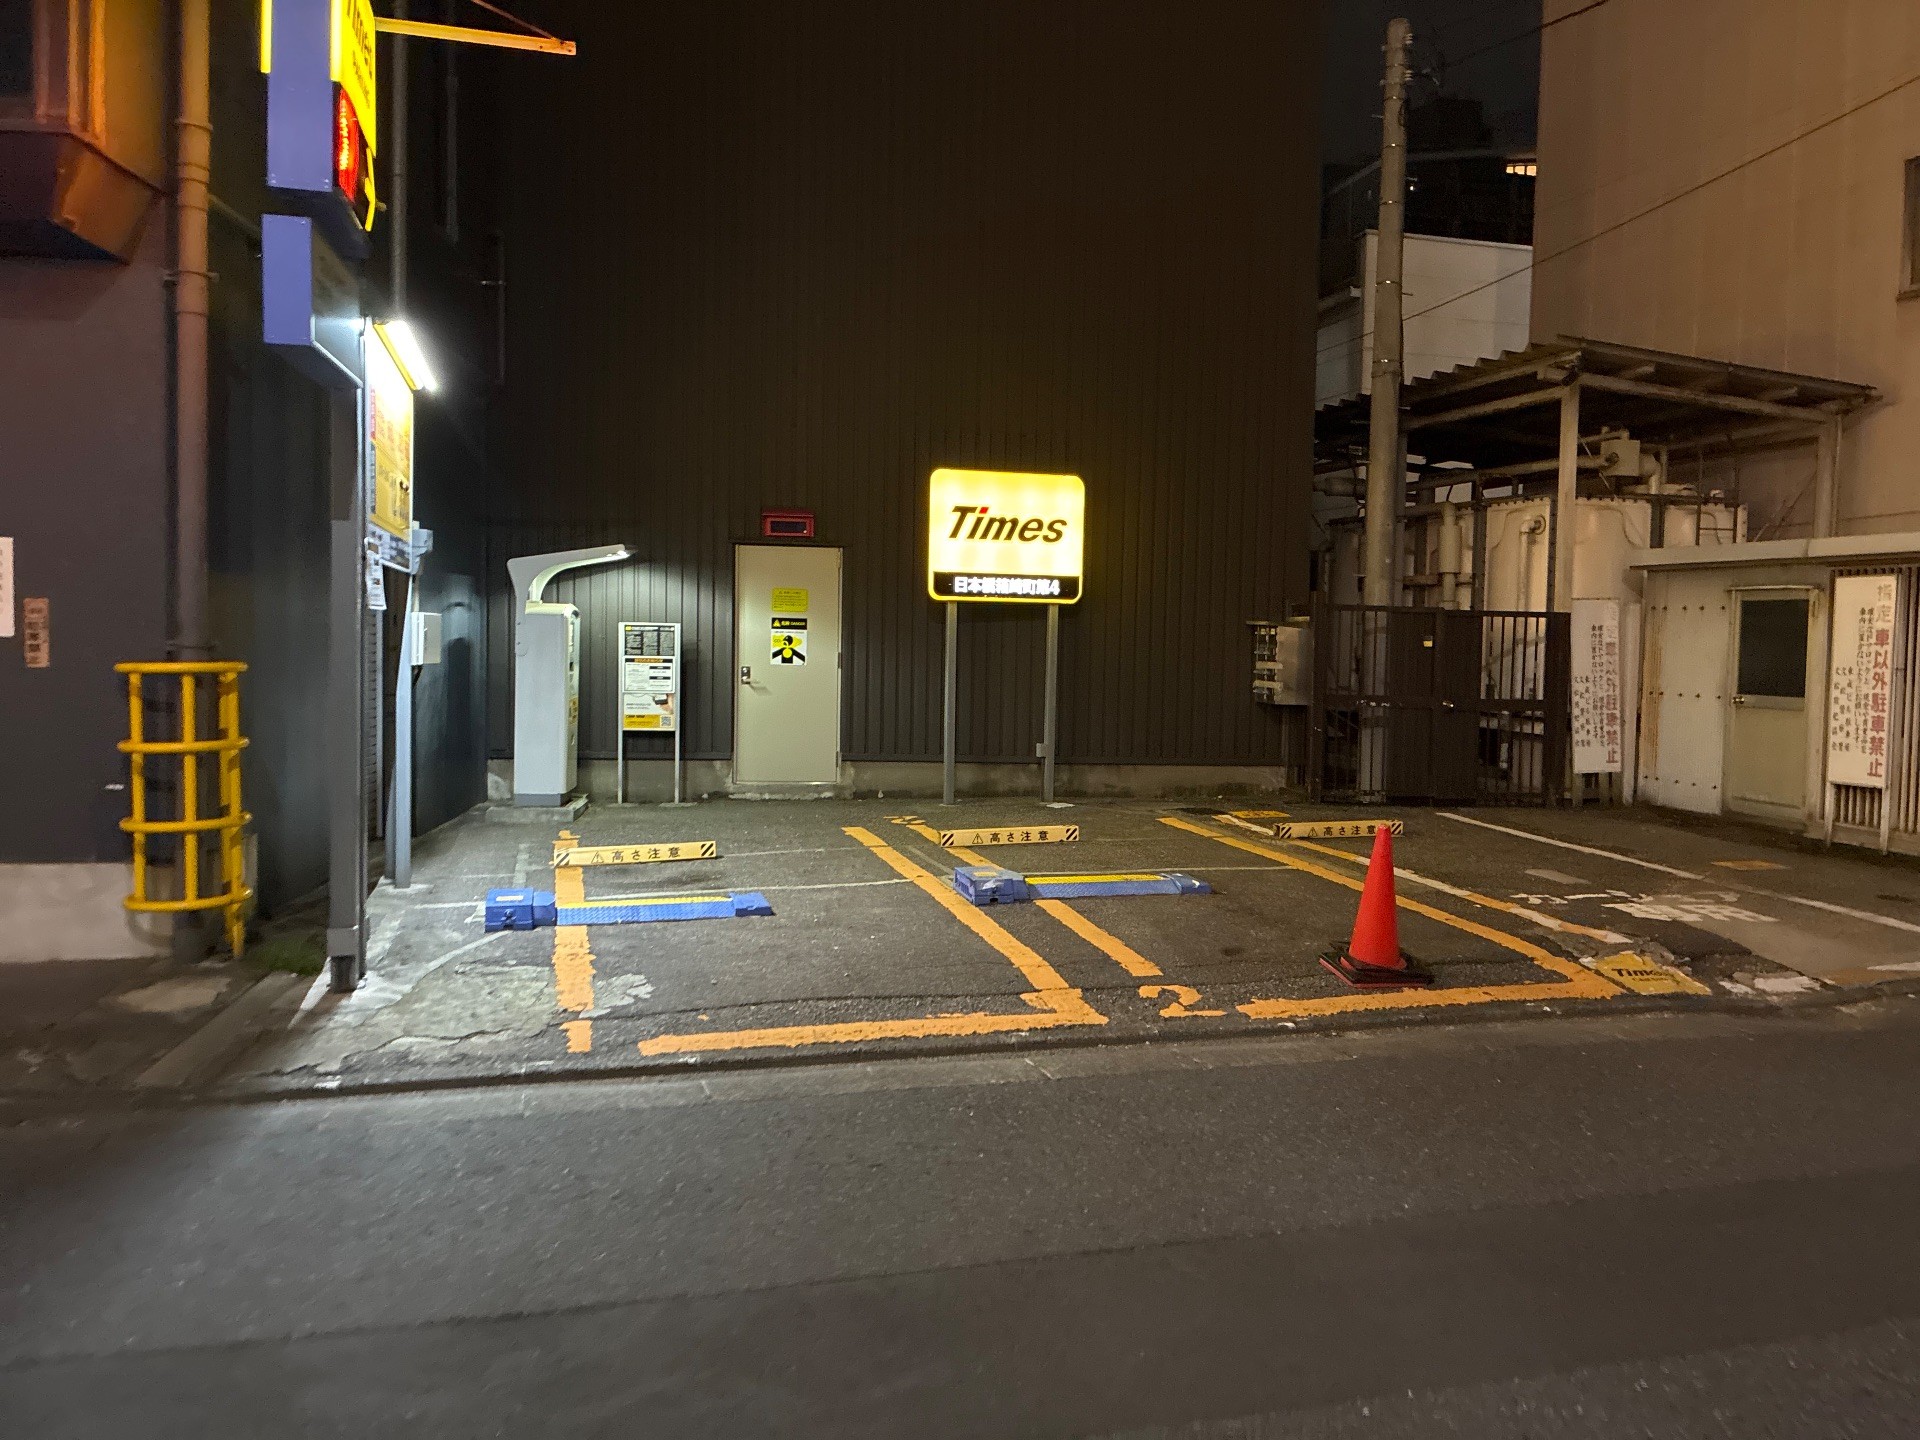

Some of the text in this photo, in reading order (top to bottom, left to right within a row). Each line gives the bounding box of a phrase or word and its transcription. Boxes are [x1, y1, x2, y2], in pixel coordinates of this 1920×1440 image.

[949, 506, 1067, 543] Times
[1867, 584, 1892, 778] 指定車以外駐車禁止
[989, 830, 1050, 843] 高さ注意
[1322, 825, 1376, 837] 高さ注意
[611, 846, 682, 862] 高さ注意
[1612, 968, 1670, 978] Tim
[1139, 985, 1228, 1017] 2
